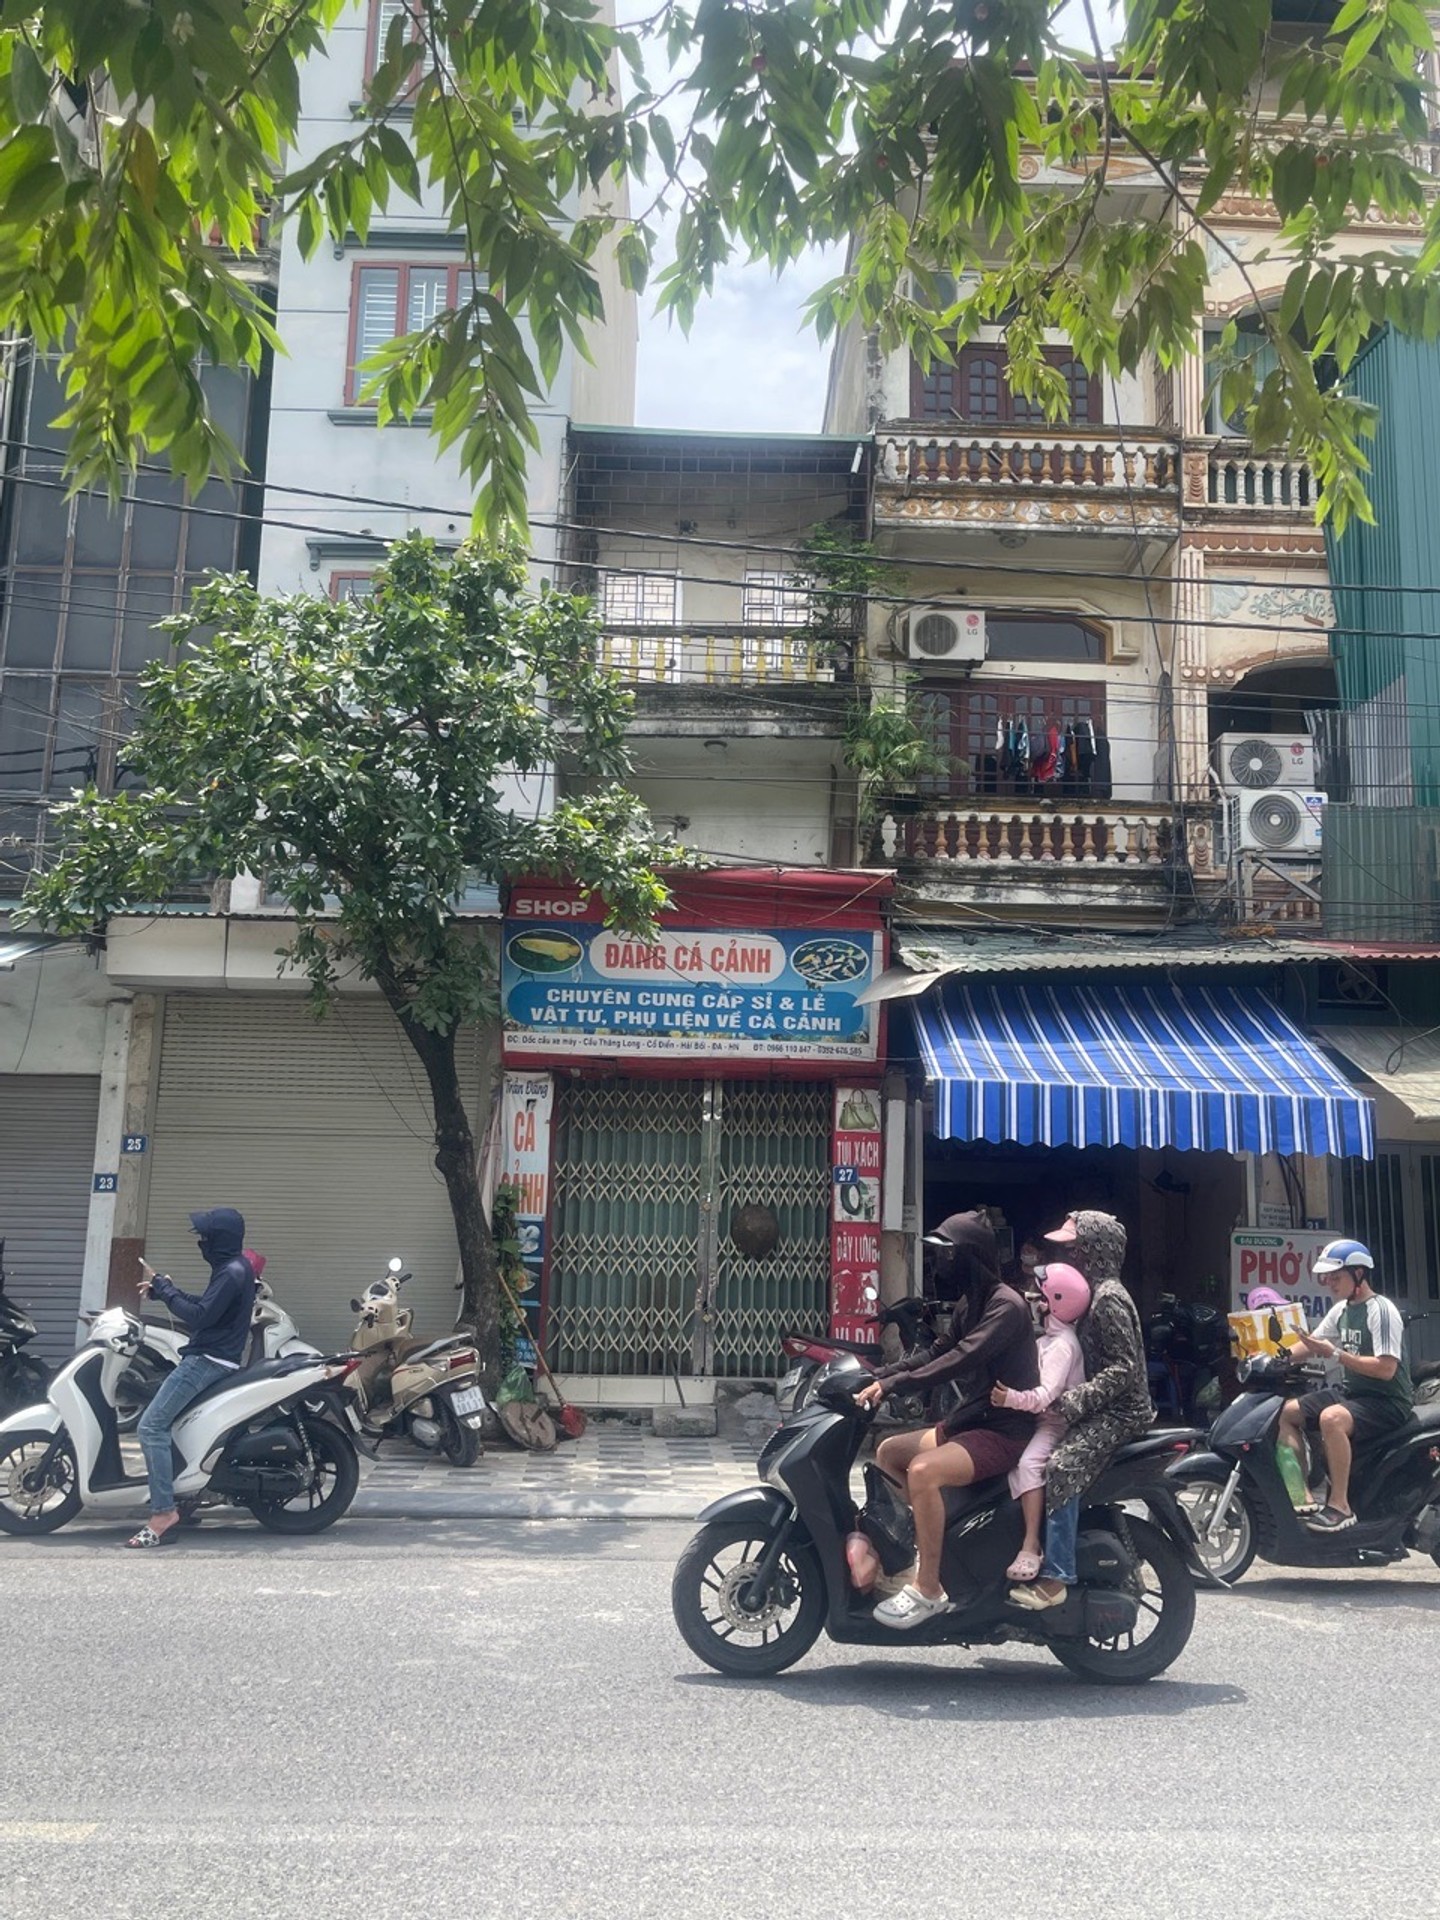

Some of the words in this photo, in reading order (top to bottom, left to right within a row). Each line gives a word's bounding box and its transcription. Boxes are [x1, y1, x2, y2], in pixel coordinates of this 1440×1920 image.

[967, 628, 978, 636] LG
[1291, 757, 1304, 765] LG
[515, 899, 588, 916] SHOP
[673, 940, 704, 972] CÁ
[711, 939, 771, 974] CẢNH
[546, 988, 632, 1006] CHUYÊN
[637, 992, 696, 1008] CUNG
[702, 989, 745, 1009] CẤP
[751, 991, 773, 1010] SỈ
[779, 997, 794, 1010] &
[801, 994, 826, 1012] LẺ
[530, 1005, 570, 1025] VẬT
[575, 1008, 607, 1026] TƯ,
[614, 1011, 657, 1029] PHỤ
[663, 1010, 710, 1031] LIỆN
[716, 1011, 742, 1029] VỀ
[748, 1013, 777, 1030] CÁ
[783, 1013, 841, 1032] CẢNH
[622, 1039, 641, 1050] Long
[127, 1138, 142, 1151] 25
[854, 1135, 880, 1168] XÁCH
[838, 1168, 854, 1182] 27
[98, 1177, 114, 1190] 23
[1240, 1240, 1304, 1286] PHỞ
